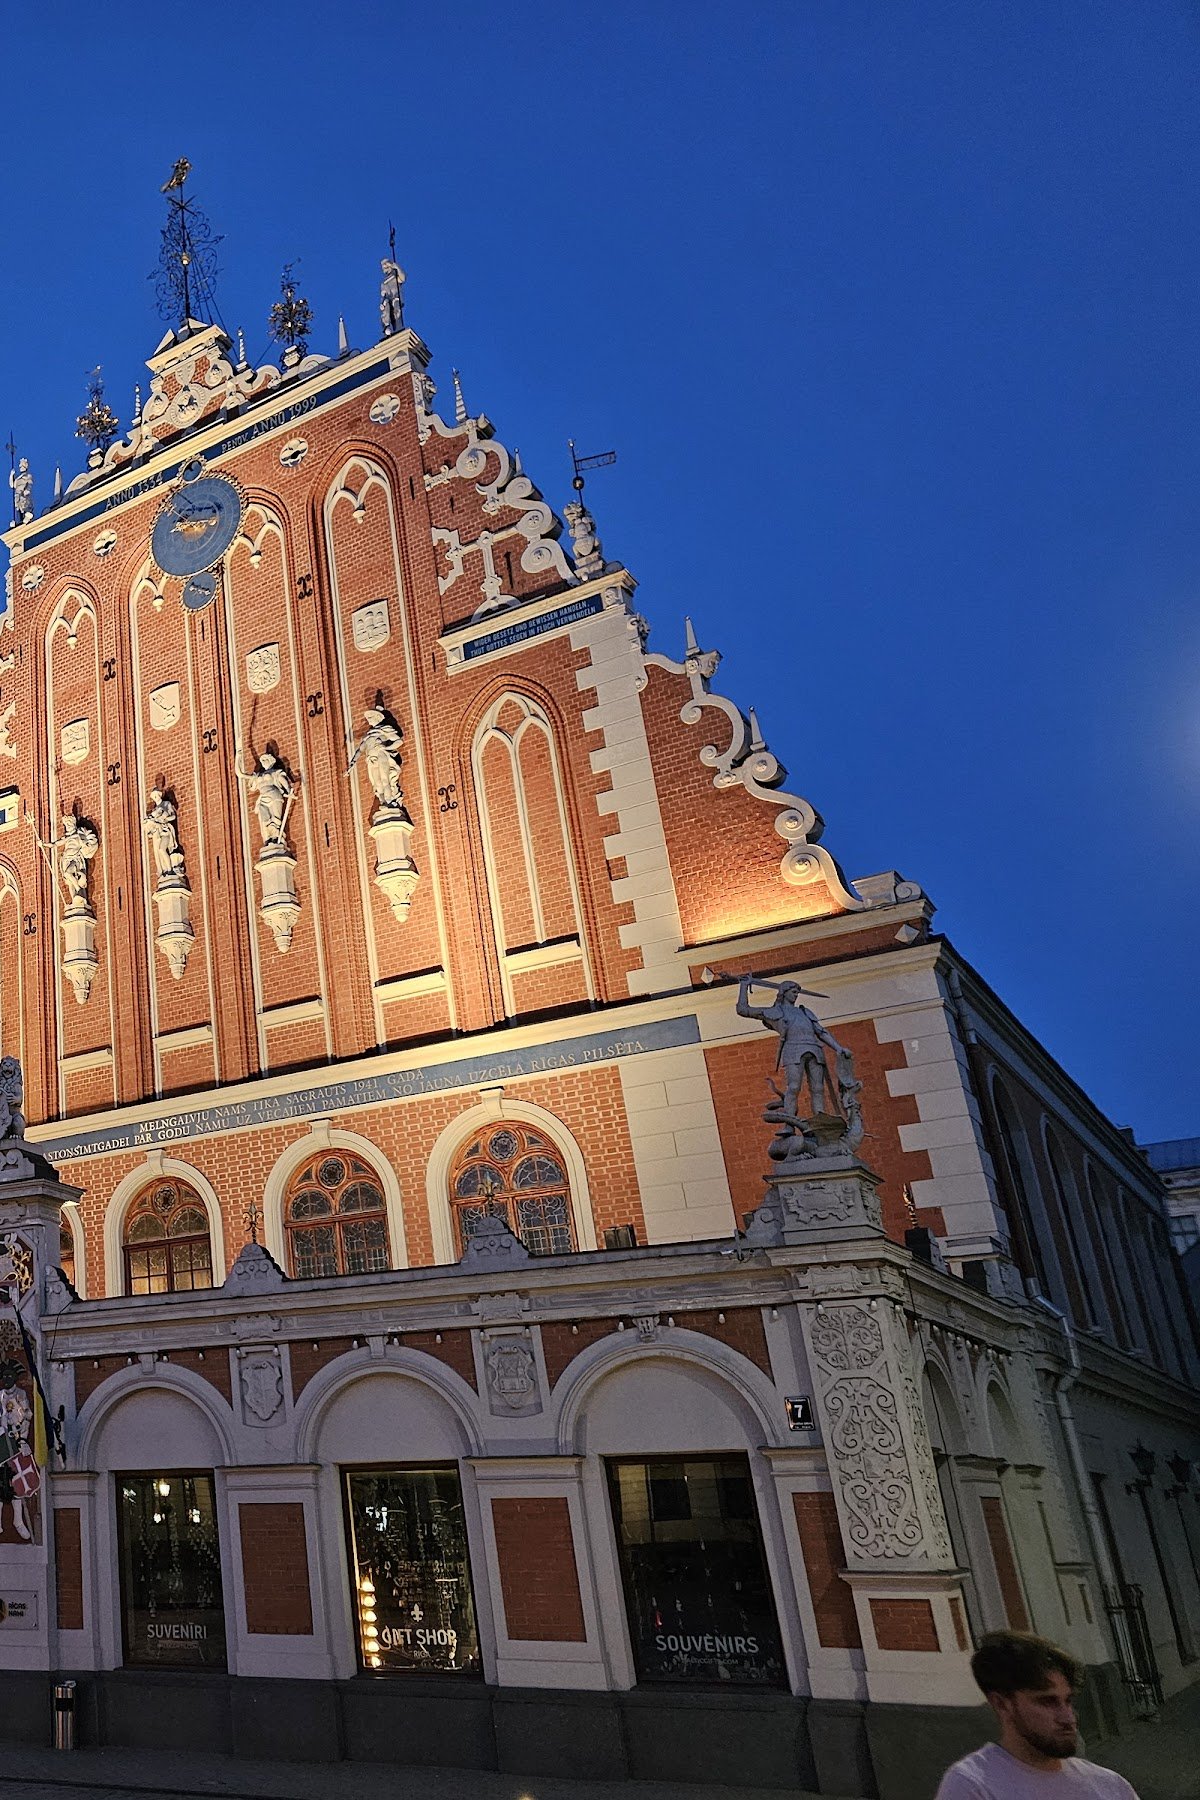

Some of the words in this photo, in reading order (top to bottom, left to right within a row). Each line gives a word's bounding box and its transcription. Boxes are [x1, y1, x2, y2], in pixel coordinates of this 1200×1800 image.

[105, 487, 134, 511] ANNO
[138, 472, 162, 496] 1334
[252, 412, 285, 438] ANNO
[289, 396, 317, 420] 1999
[134, 1134, 153, 1145] PAR
[158, 1126, 190, 1140] GODU
[196, 1118, 230, 1133] NAMU
[236, 1114, 253, 1126] UZ
[322, 1090, 386, 1110] PAMATIEM
[392, 1084, 413, 1096] NO
[530, 1054, 576, 1071] RĪGAS
[139, 1111, 210, 1134] MELNGALVJU
[214, 1104, 246, 1118] NAMS
[252, 1098, 281, 1110] TIKA
[286, 1085, 346, 1105] SAGRAUTS
[794, 1404, 803, 1418] 7
[147, 1622, 207, 1639] SUVENĪRI
[382, 1628, 412, 1646] GIFT
[416, 1629, 456, 1646] SHOP
